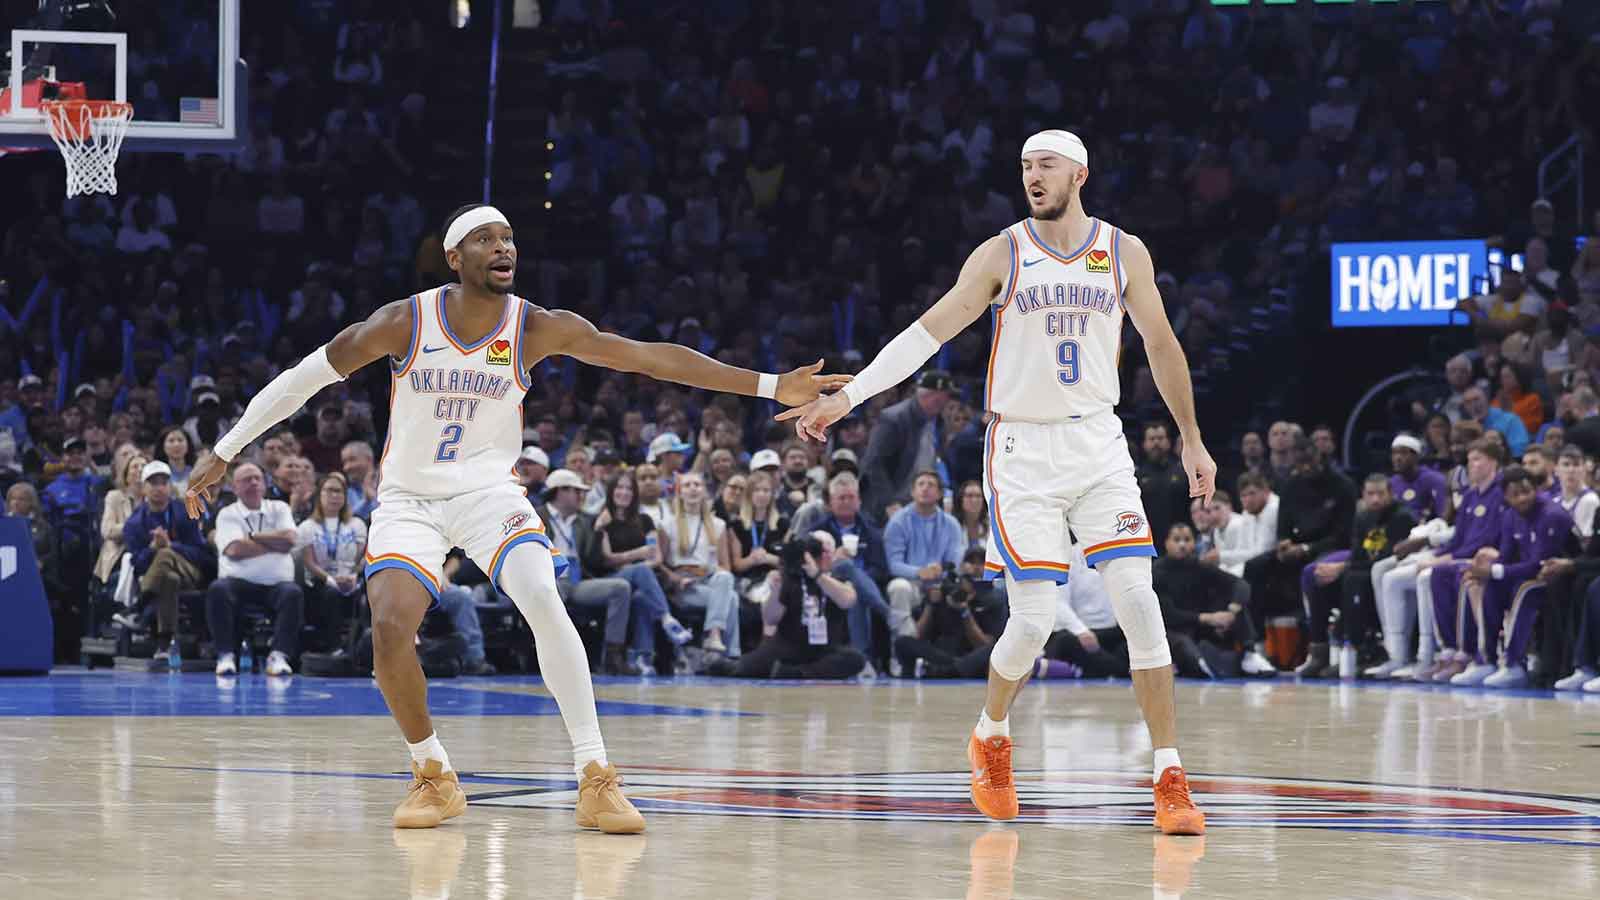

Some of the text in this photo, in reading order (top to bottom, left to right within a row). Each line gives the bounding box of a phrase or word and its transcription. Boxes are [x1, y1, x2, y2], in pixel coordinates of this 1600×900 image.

[1014, 283, 1116, 317] OKLAHOMA
[1045, 312, 1090, 337] CITY
[1056, 339, 1082, 386] 9
[409, 368, 513, 400] OKLAHOMA
[434, 396, 480, 421] CITY
[434, 422, 464, 463] 2
